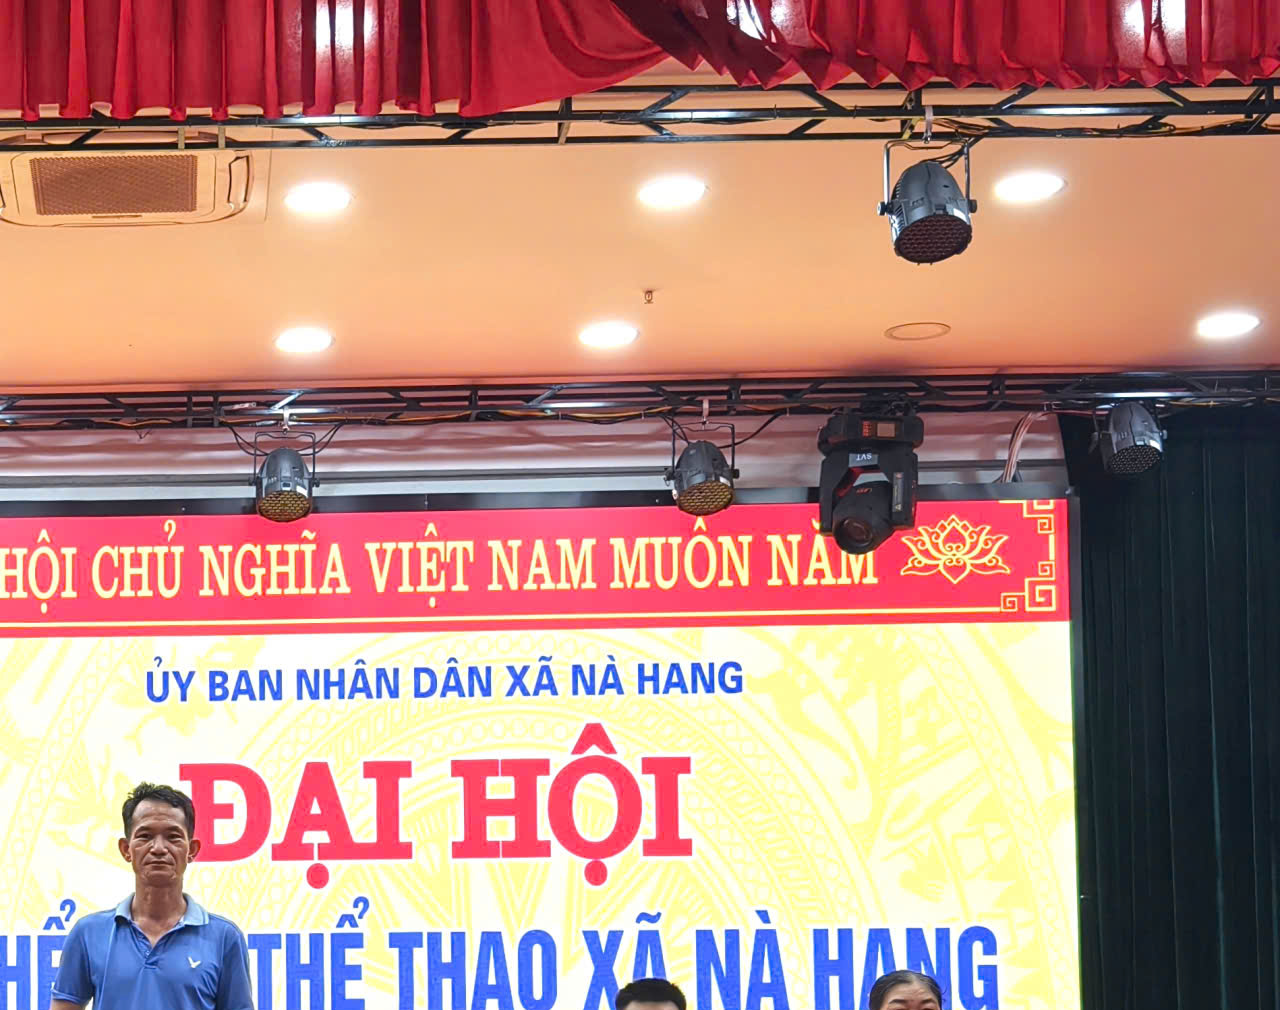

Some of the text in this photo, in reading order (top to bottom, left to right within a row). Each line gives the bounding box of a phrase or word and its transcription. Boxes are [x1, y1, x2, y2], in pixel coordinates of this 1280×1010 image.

[92, 520, 184, 598] CHỦ
[199, 530, 351, 596] NGHĨA
[365, 523, 474, 608] VIỆT
[488, 538, 597, 590] NAM
[610, 517, 752, 589] MUÔN
[146, 656, 743, 703] ỦY BAN NHÂN DÂN XÃ NÀ HANG
[179, 724, 692, 889] ĐẠI HỘI
